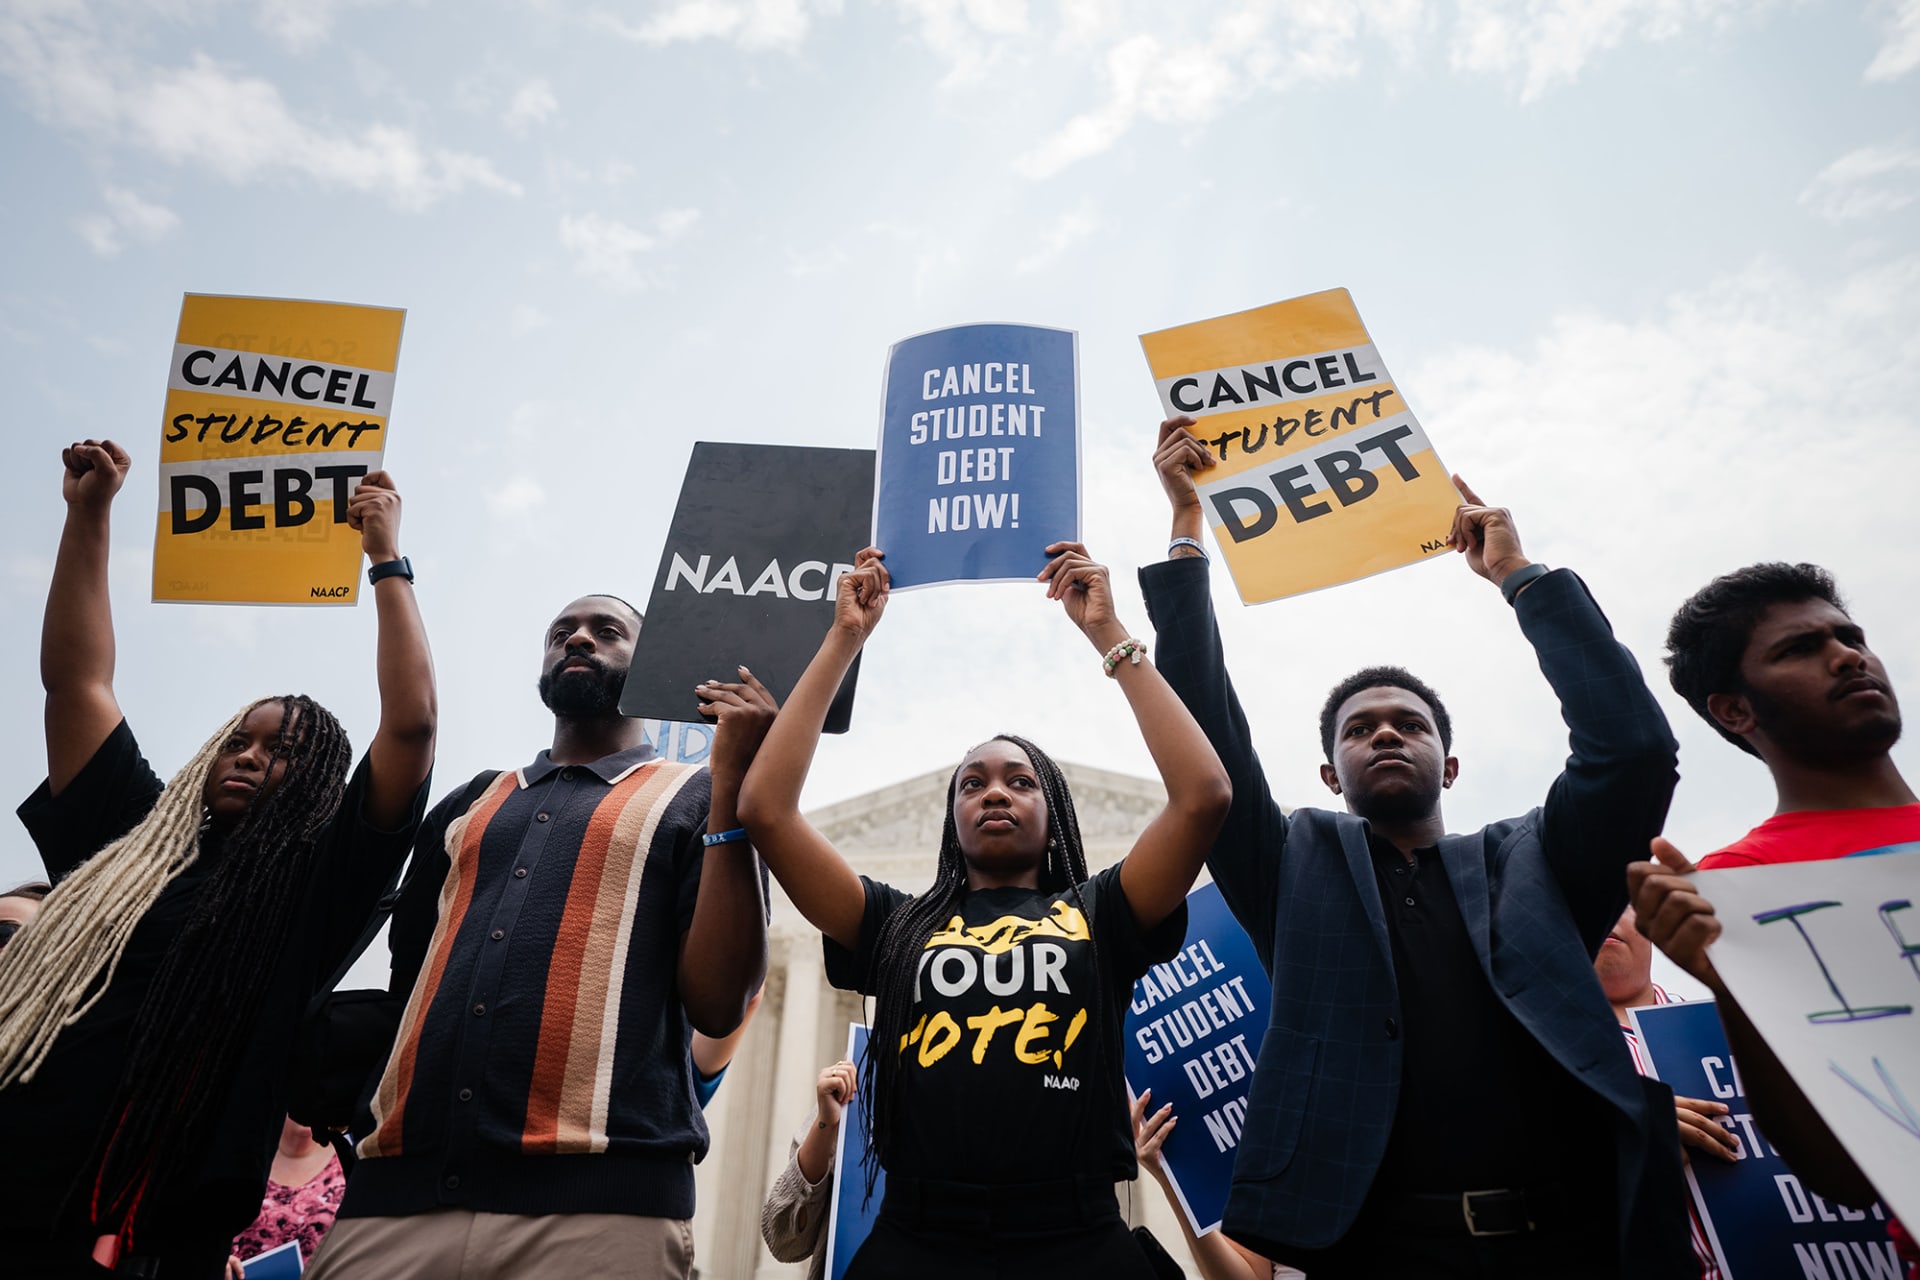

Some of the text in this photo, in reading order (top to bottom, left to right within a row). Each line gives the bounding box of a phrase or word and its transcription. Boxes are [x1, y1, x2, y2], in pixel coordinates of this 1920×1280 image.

[182, 350, 376, 409] CANCEL
[922, 363, 1035, 400] CANCEL
[1169, 352, 1376, 412] CANCEL
[166, 414, 380, 448] STUDENT
[910, 404, 1045, 445] STUDENT
[1199, 389, 1394, 460] TUDENT
[937, 448, 1015, 485] DEBT
[1209, 424, 1421, 544] DEBT
[170, 465, 368, 534] DEBT
[928, 493, 1019, 533] NOW!
[310, 587, 350, 597] NAACP
[1136, 975, 1255, 1065] STUDENT
[1044, 1074, 1080, 1091] NAACP
[1183, 1033, 1256, 1100] DEBT
